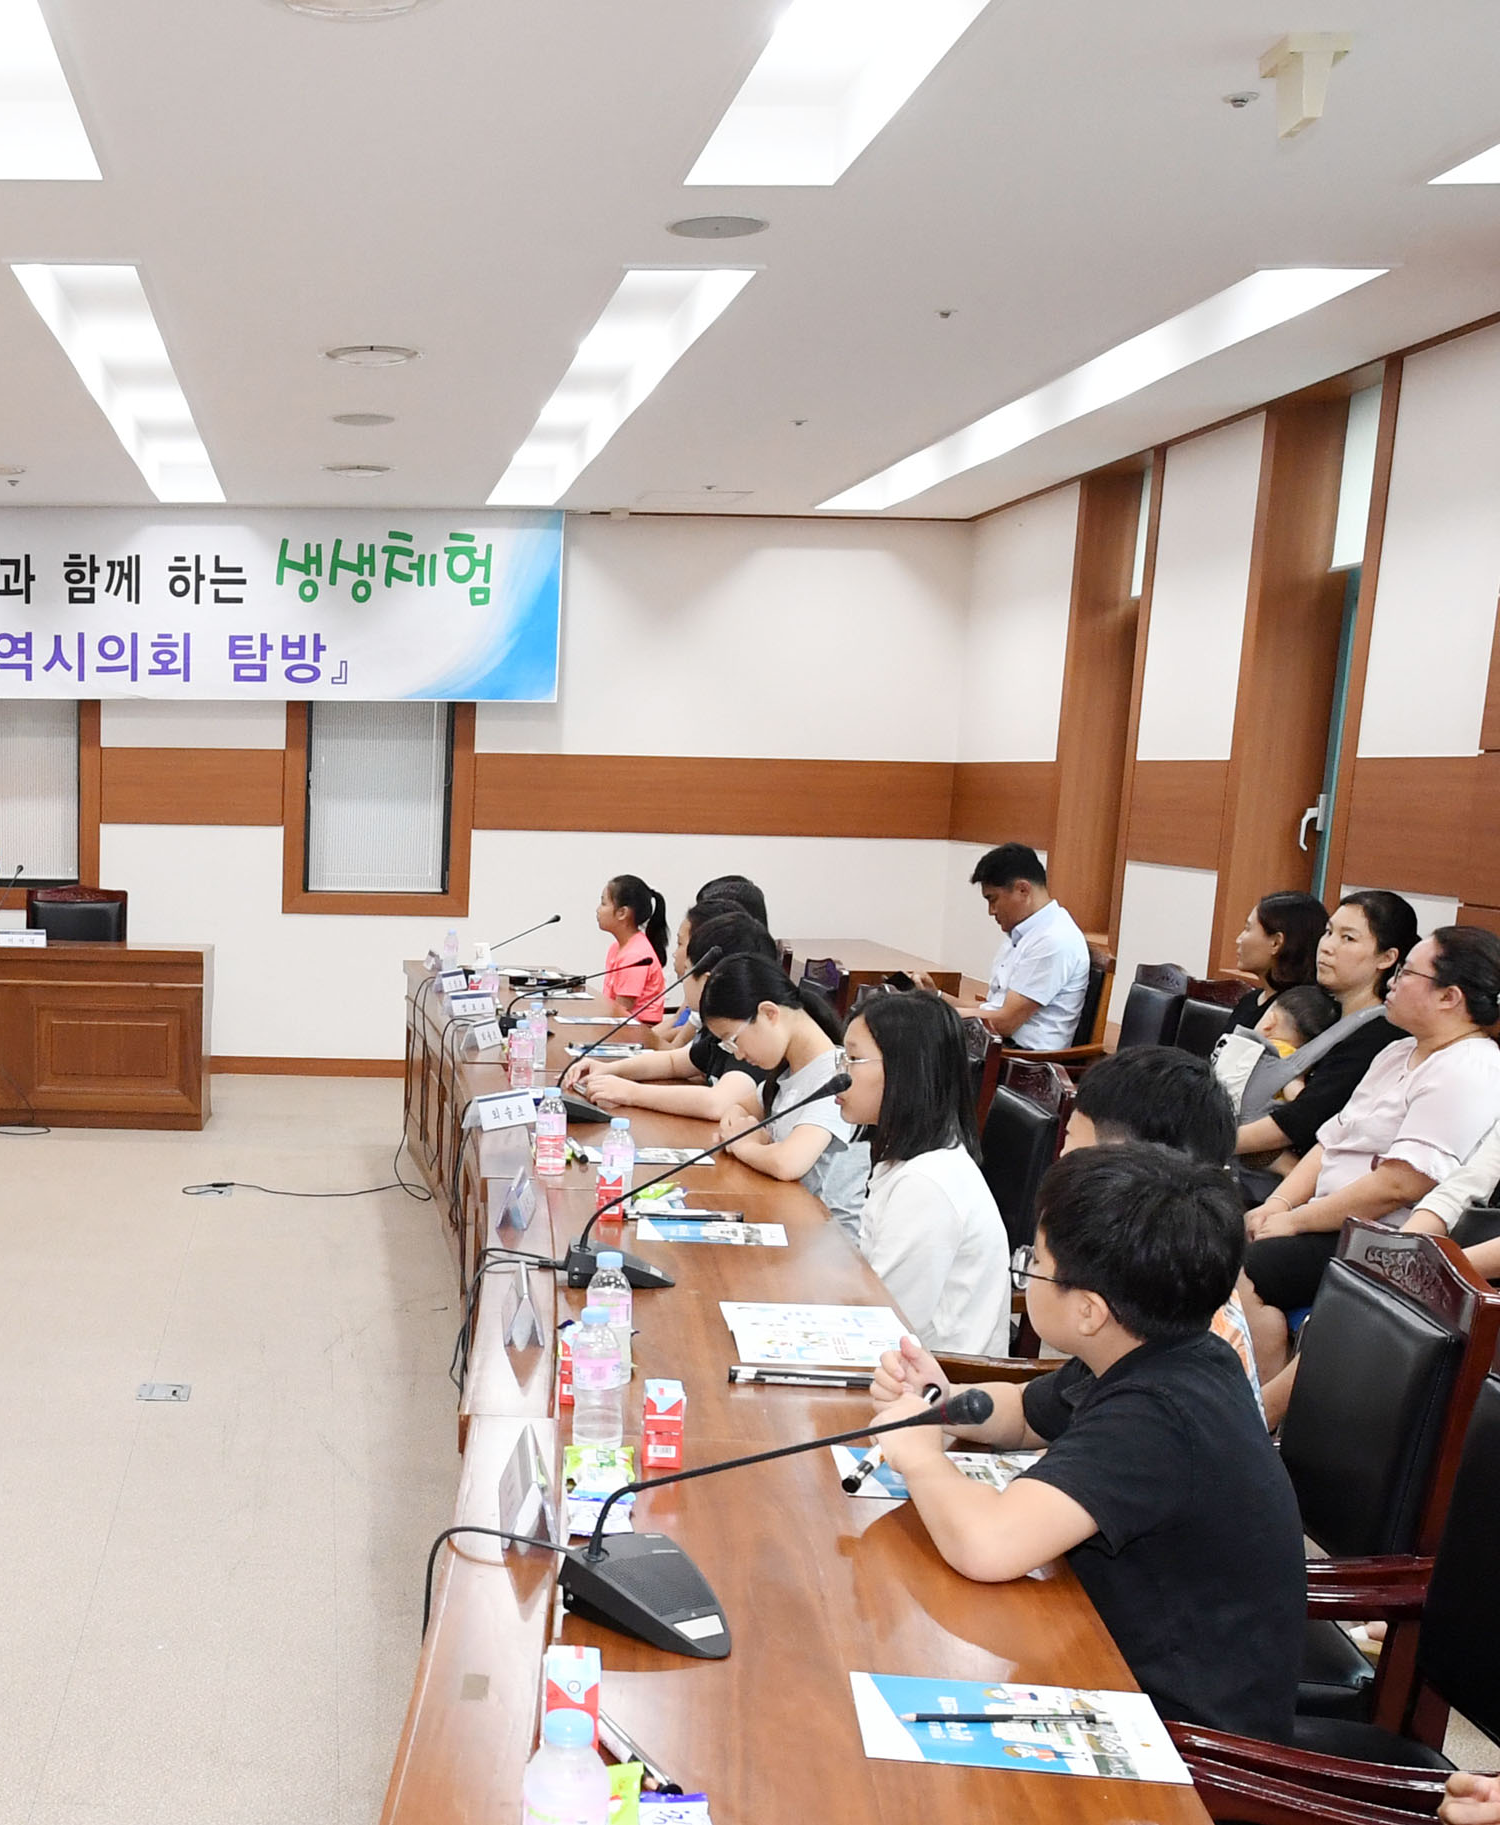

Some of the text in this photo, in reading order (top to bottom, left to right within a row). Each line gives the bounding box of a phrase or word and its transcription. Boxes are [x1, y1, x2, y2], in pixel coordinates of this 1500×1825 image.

[63, 553, 141, 604] 함께
[168, 554, 247, 604] 하는
[276, 530, 493, 606] 생생체험
